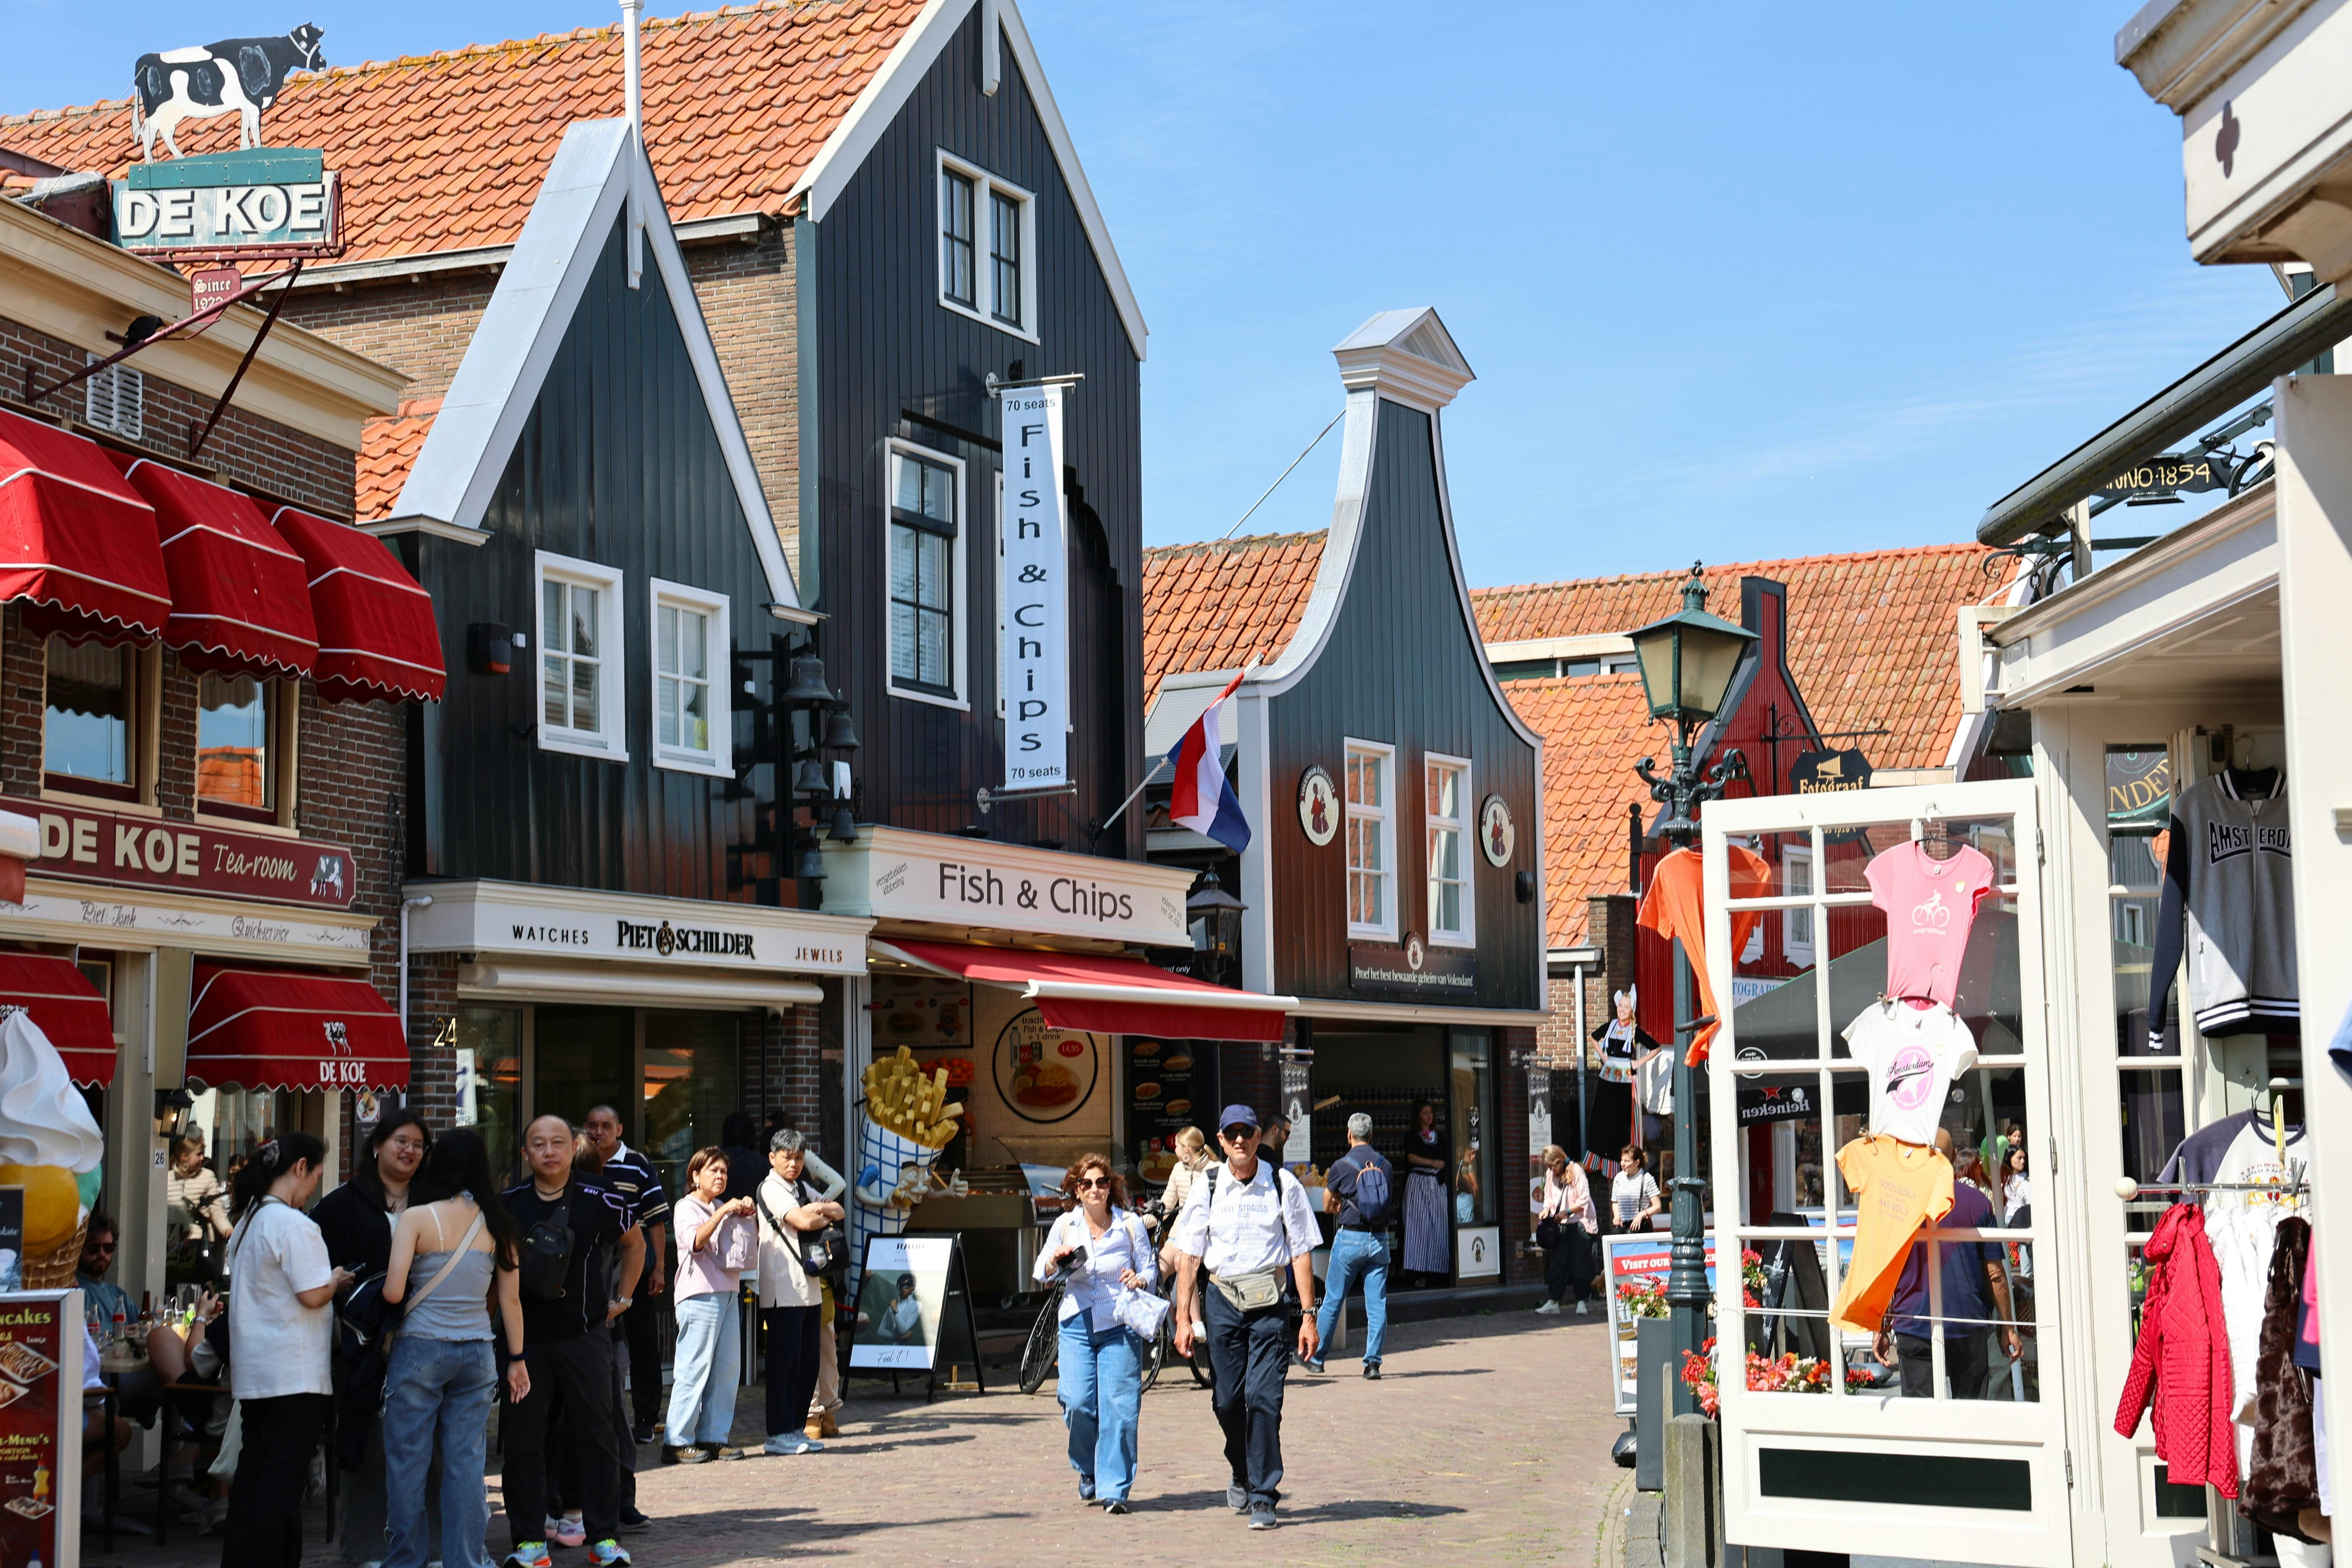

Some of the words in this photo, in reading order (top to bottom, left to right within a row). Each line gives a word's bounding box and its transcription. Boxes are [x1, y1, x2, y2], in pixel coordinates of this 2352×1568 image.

[120, 190, 194, 238] DE
[216, 184, 324, 235] KOE
[194, 278, 231, 295] Since
[1007, 400, 1020, 411] 70
[1024, 398, 1055, 410] seats
[1019, 424, 1044, 539] Fish
[1018, 564, 1047, 583] &
[1014, 604, 1047, 751] Chips
[1011, 768, 1025, 780] 70
[1029, 765, 1061, 778] seats
[40, 813, 97, 864] DE
[115, 824, 200, 877] KOE
[213, 843, 298, 882] Tea-room
[939, 862, 1003, 906] Fish
[1017, 880, 1038, 910] &
[1050, 878, 1133, 922] Chips
[232, 915, 290, 942] Quickservice
[513, 924, 588, 945] WATCHES
[617, 921, 656, 948] PIET
[676, 929, 756, 959] SCHILDER
[795, 947, 843, 963] JEWELS
[1176, 965, 1191, 974] only
[1355, 967, 1371, 980] Proef
[1371, 968, 1380, 980] het
[1380, 968, 1392, 981] best
[1393, 969, 1418, 983] bewaarde
[1418, 971, 1437, 986] geheim
[1437, 975, 1446, 985] van
[1447, 973, 1473, 987] Volendam!
[433, 1016, 457, 1047] 24
[320, 1061, 337, 1082] DE
[340, 1061, 366, 1083] KOE
[1886, 1058, 1932, 1078] Amsterdam
[155, 1152, 165, 1164] 26
[1879, 1178, 1897, 1193] GOOD
[1898, 1186, 1917, 1199] GIRLS
[1238, 1203, 1268, 1213] STRAUSS
[1879, 1196, 1891, 1209] BAD
[1892, 1202, 1908, 1215] GIRLS
